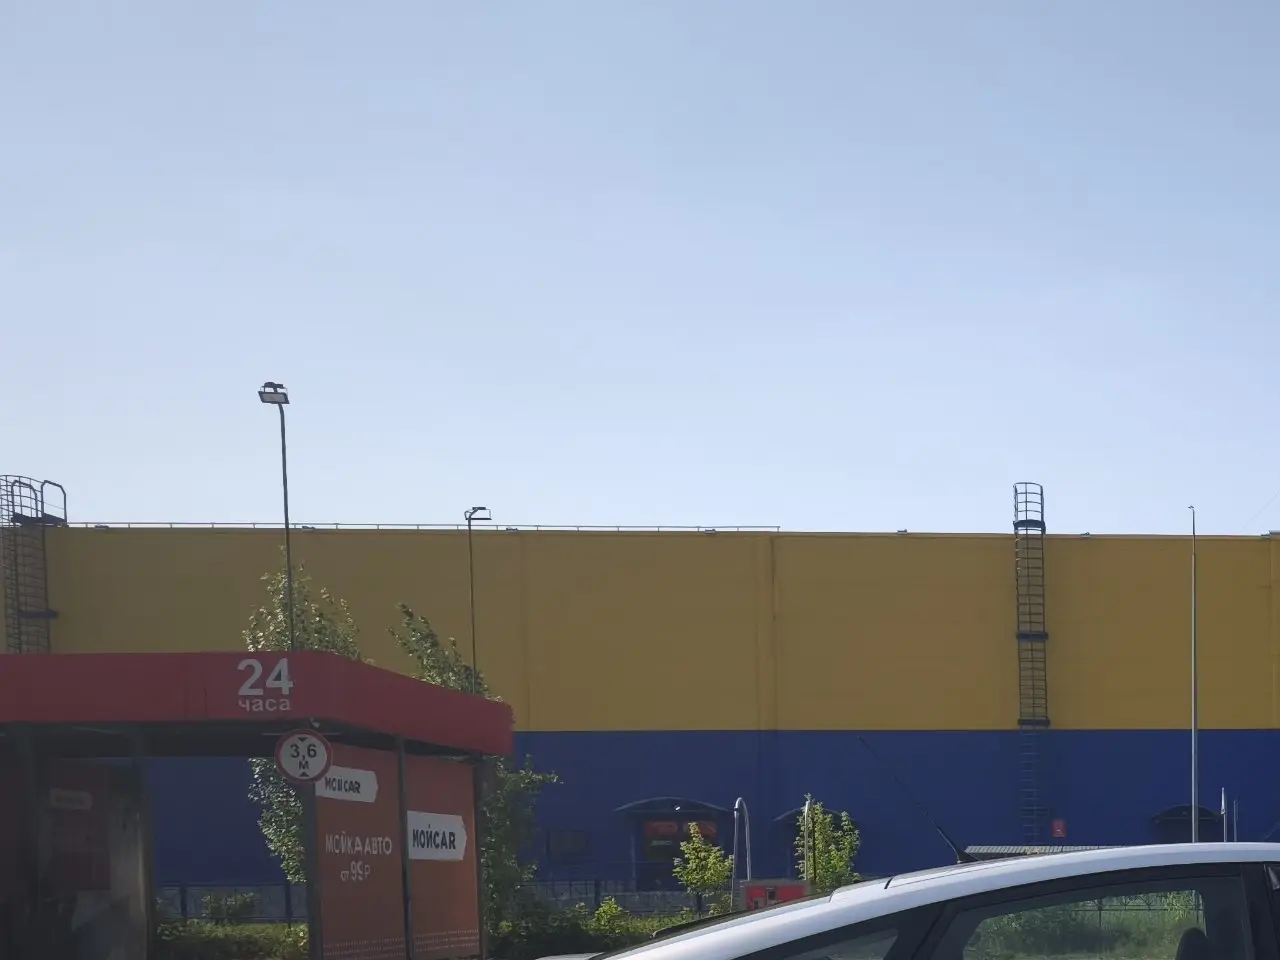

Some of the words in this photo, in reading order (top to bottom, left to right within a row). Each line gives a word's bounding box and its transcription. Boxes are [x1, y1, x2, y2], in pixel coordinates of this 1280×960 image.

[237, 657, 294, 695] 24
[238, 698, 291, 712] часа
[290, 743, 317, 761] 3,6
[325, 830, 363, 855] МОЙКА
[364, 836, 393, 856] АВТО
